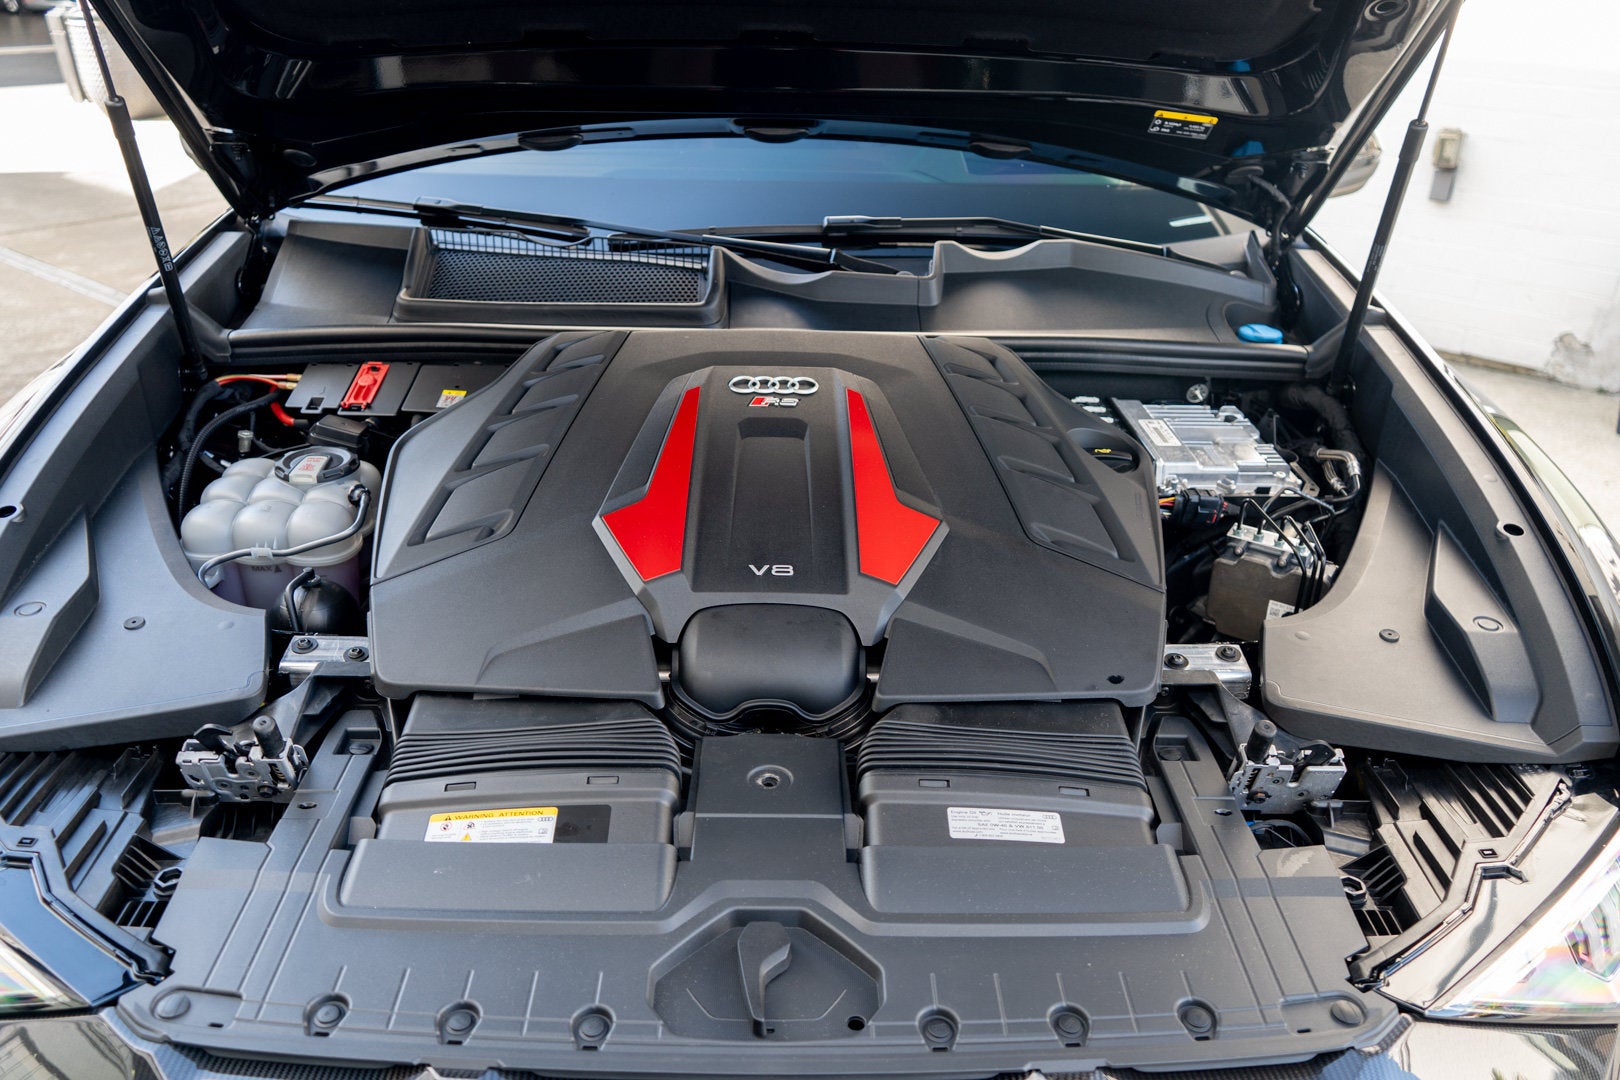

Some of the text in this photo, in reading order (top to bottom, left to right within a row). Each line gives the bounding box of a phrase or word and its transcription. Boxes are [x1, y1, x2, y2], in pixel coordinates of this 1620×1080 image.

[749, 396, 799, 407] RS
[748, 564, 794, 576] V8
[454, 812, 494, 820] WARNING
